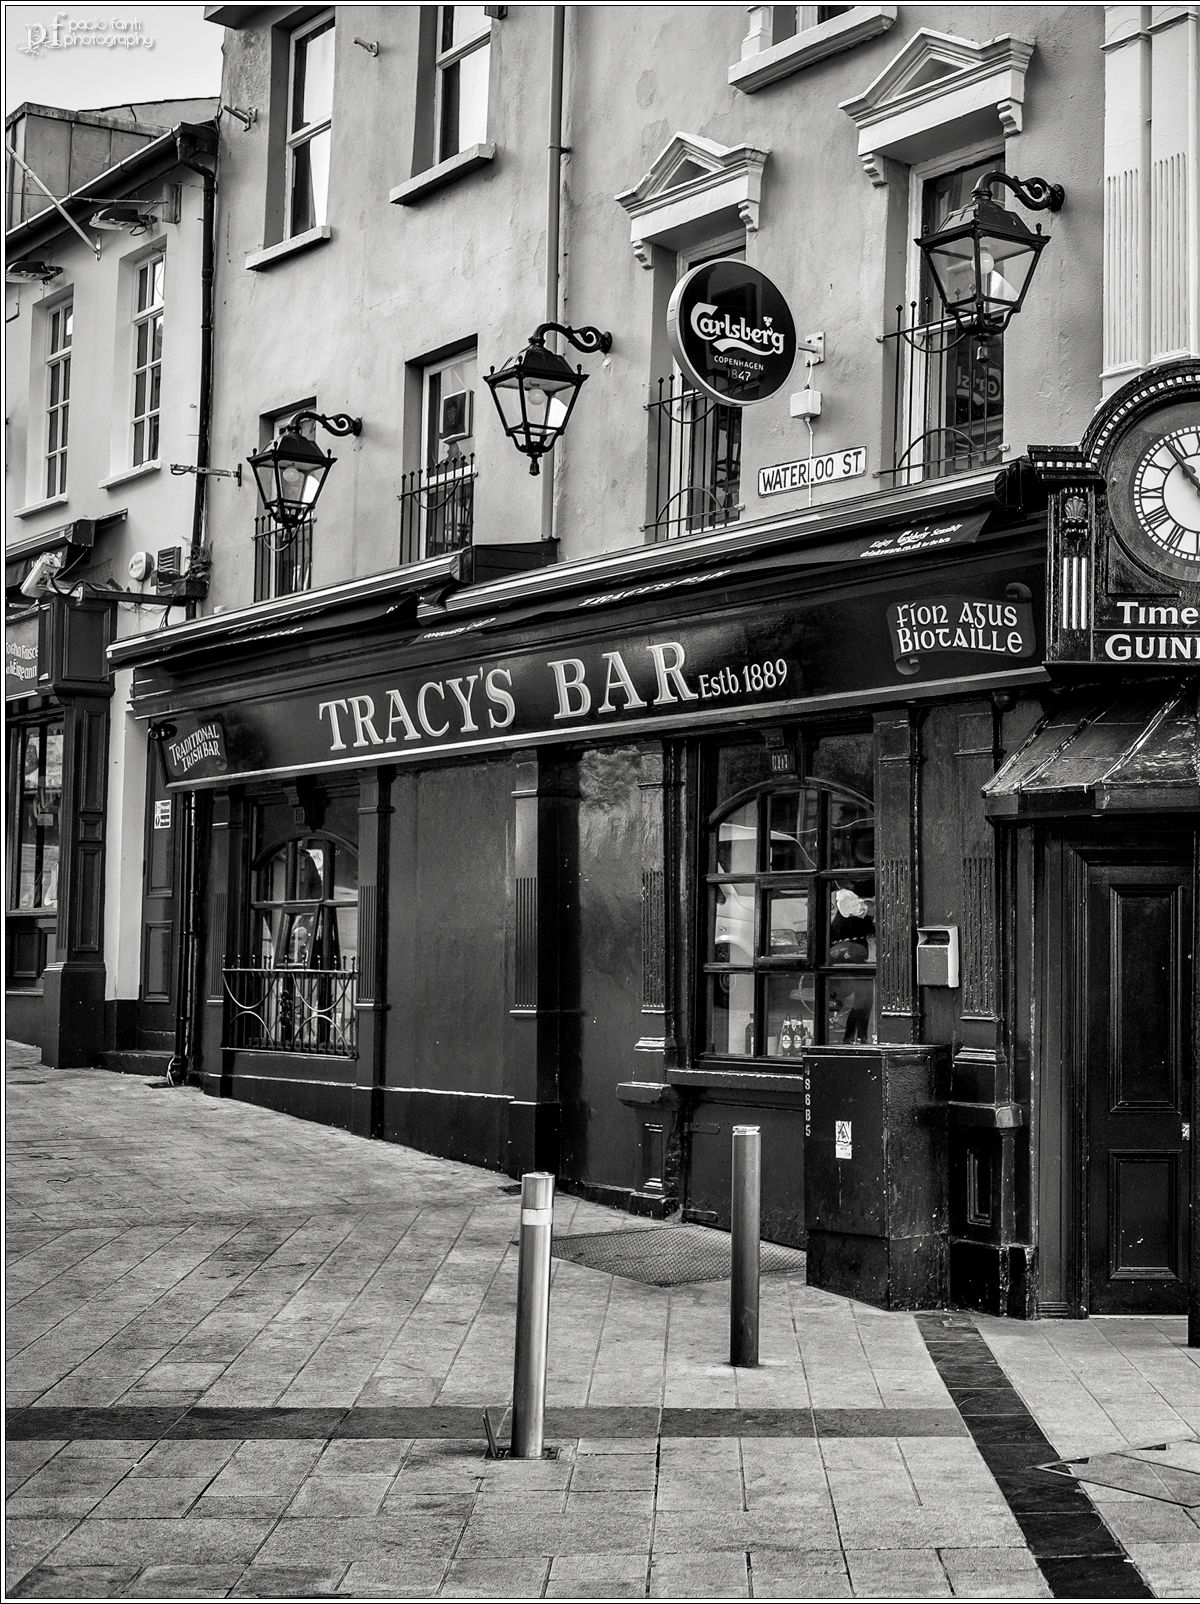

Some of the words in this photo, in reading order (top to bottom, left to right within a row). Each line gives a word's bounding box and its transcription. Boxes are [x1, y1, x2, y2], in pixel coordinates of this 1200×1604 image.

[690, 302, 785, 355] Carlsberg
[713, 354, 765, 372] COPENHAGEN
[727, 369, 752, 382] 1847
[762, 457, 834, 492] WATERLOO
[843, 450, 862, 475] ST
[1117, 601, 1199, 625] Time
[318, 665, 516, 752] TRACY'S
[547, 641, 699, 721] BAR
[168, 724, 220, 766] TRADITIONAL
[181, 745, 203, 772] IRISH
[202, 740, 220, 758] BAR
